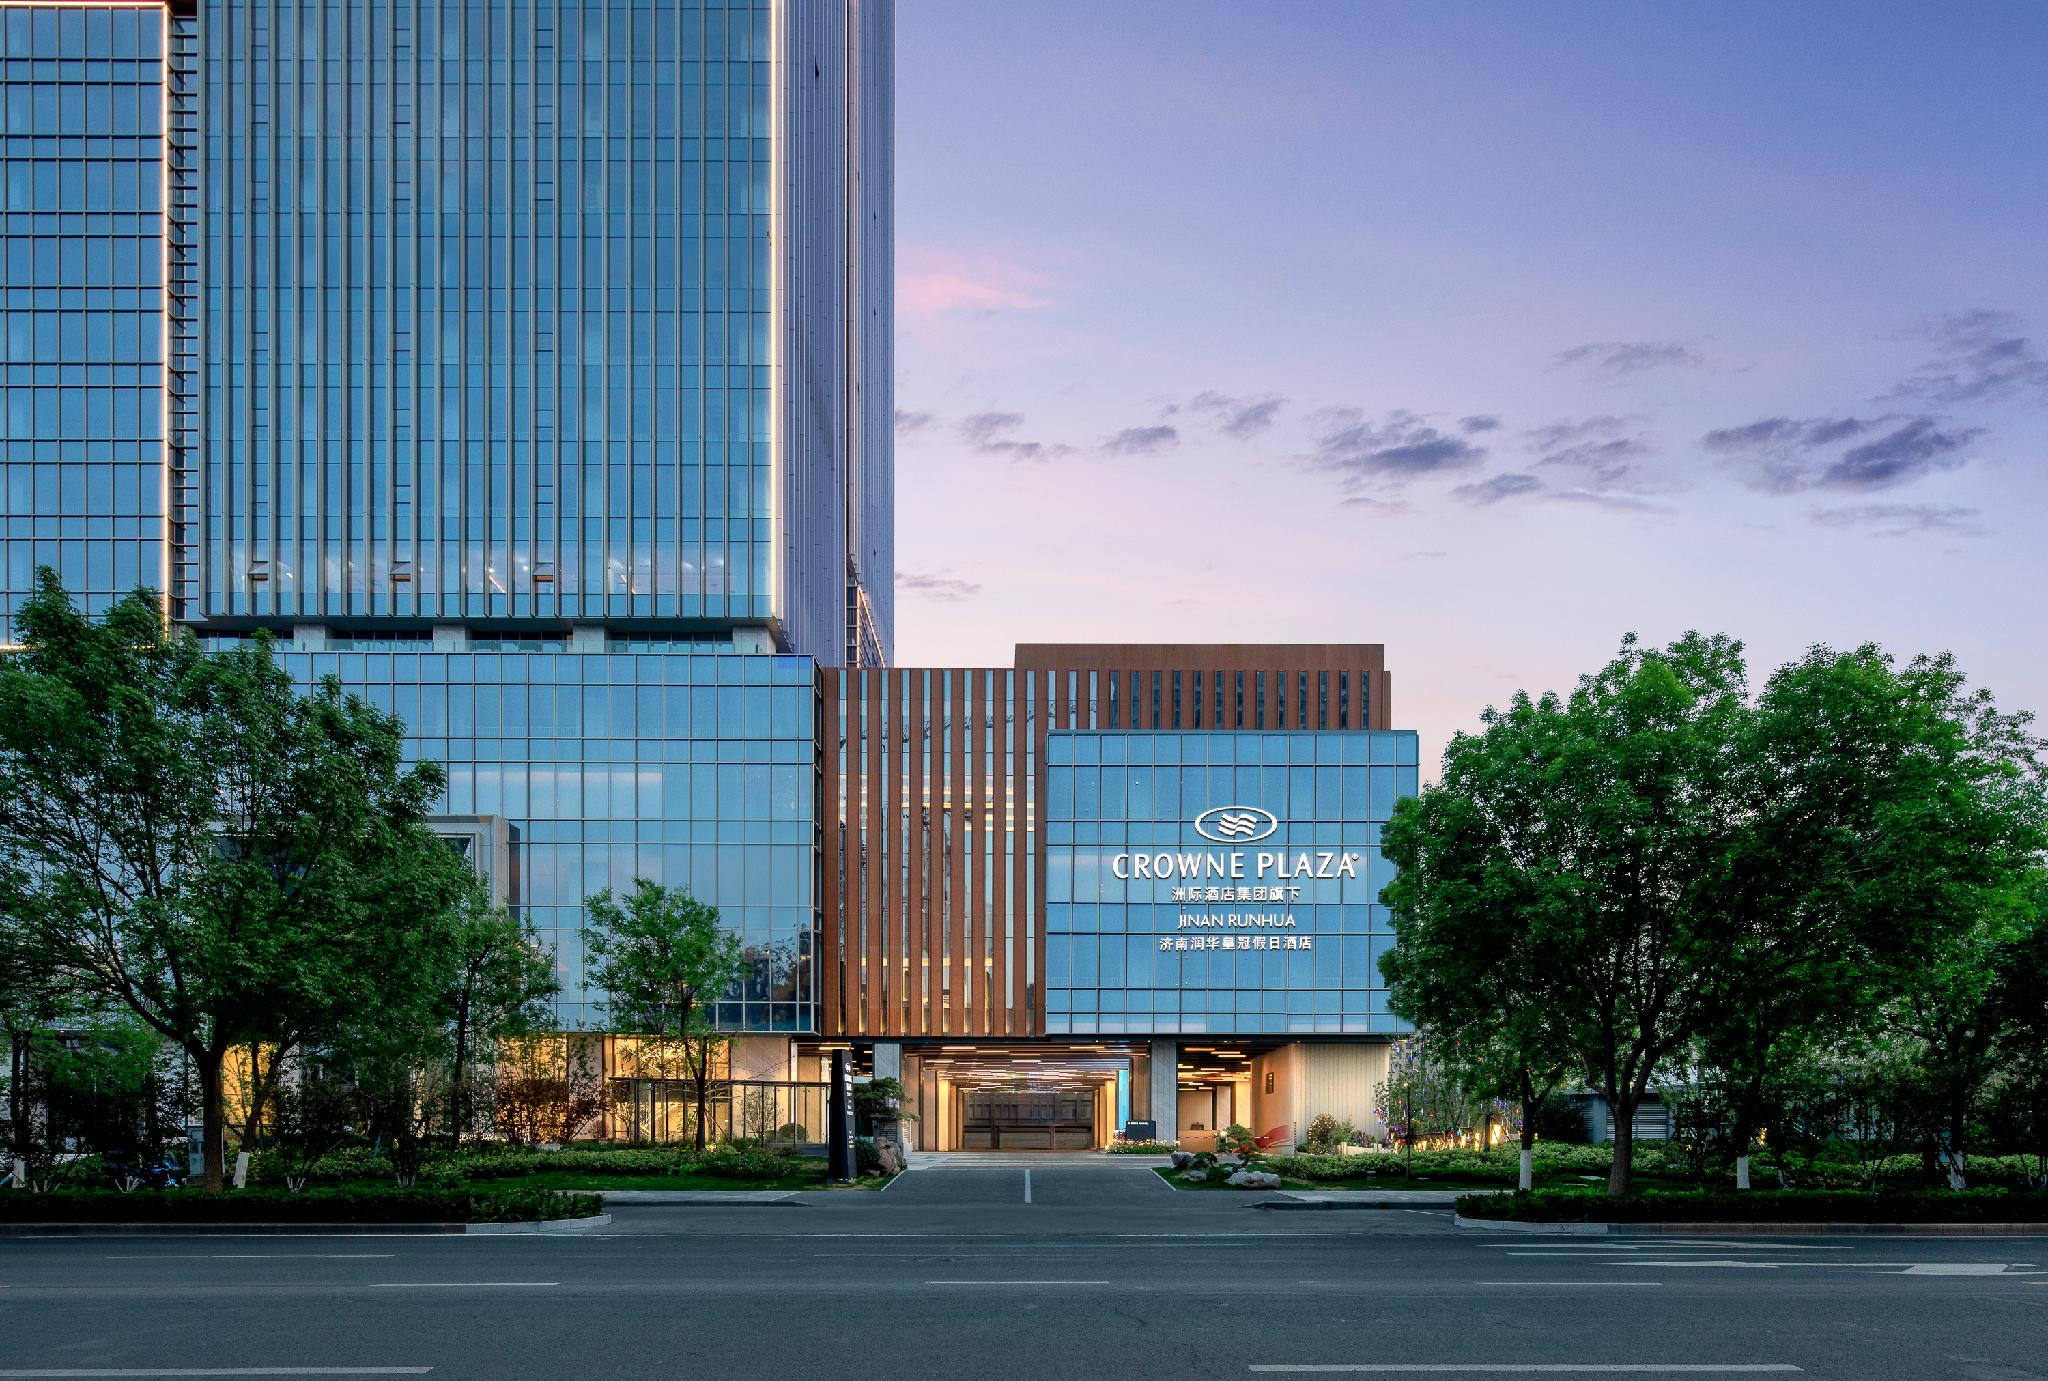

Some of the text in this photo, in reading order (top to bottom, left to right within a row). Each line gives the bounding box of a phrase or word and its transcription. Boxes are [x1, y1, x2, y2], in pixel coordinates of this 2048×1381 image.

[1112, 853, 1245, 879] CROWNE
[1171, 886, 1301, 902] 洲际酒店集团旗下
[1177, 913, 1296, 929] JINAN RUNHUA
[1159, 936, 1313, 951] 济南润华皇冠假日酒店
